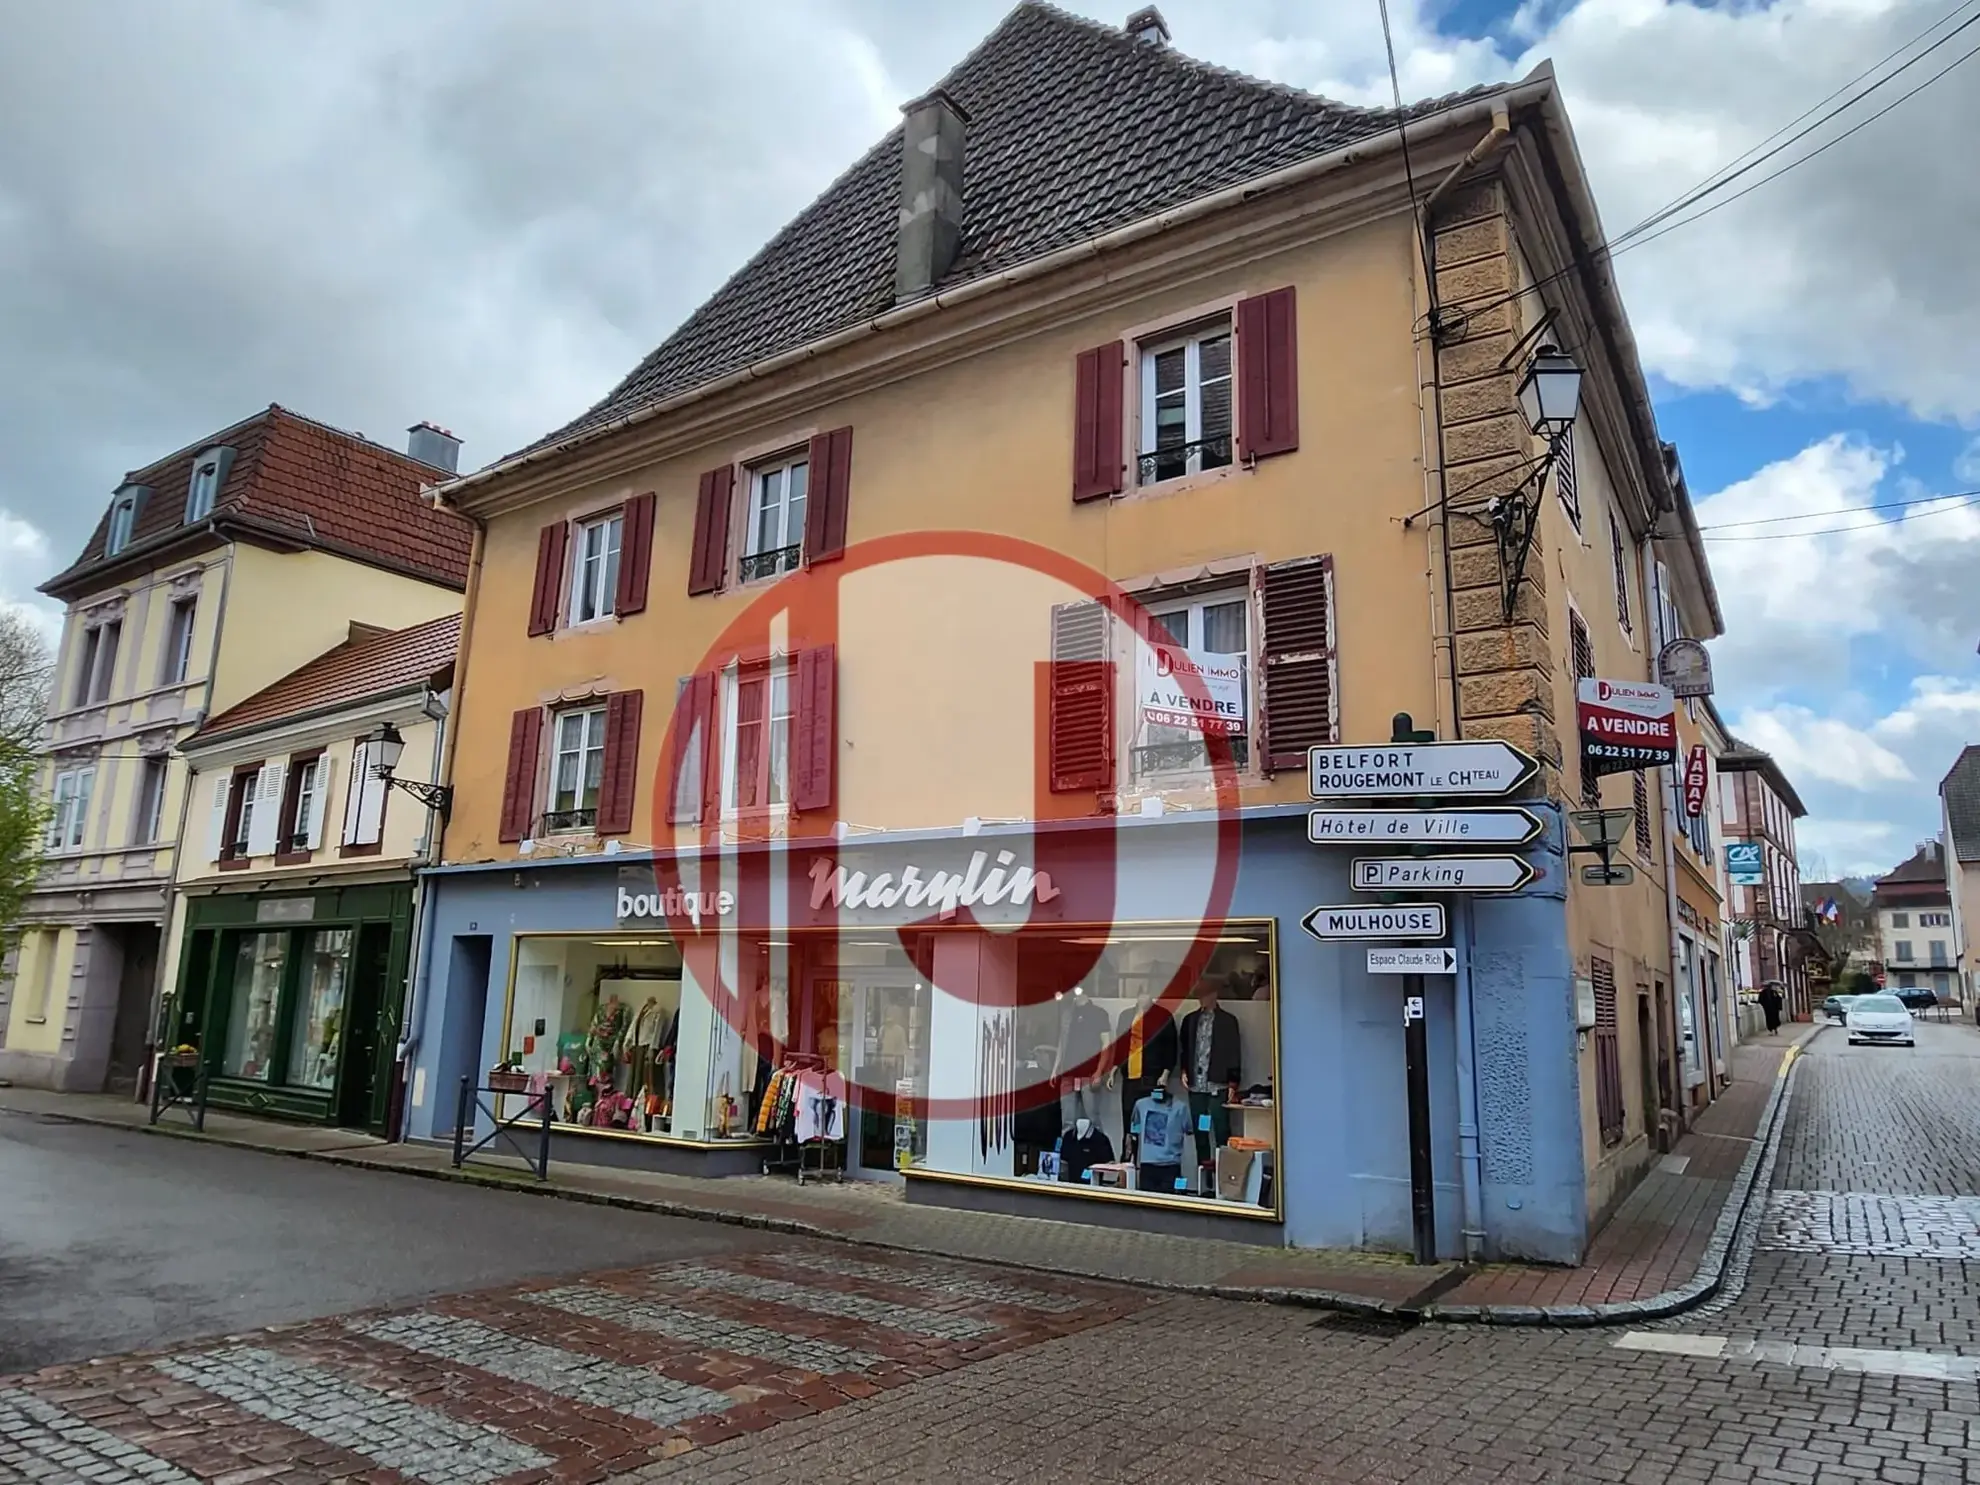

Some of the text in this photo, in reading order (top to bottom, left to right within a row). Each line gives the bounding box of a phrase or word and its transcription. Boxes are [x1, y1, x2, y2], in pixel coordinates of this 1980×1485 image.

[1207, 665, 1238, 679] IMMO
[1636, 690, 1660, 699] IMMO
[1166, 693, 1237, 714] VENDRE
[1156, 713, 1241, 731] 06 22 51 77 39
[1587, 716, 1670, 737] A VENDRE
[1319, 752, 1413, 769] BELFORT
[1588, 744, 1670, 761] 06 22 51 77 39
[1319, 772, 1425, 789] ROUGEMONT
[1430, 777, 1443, 786] LE
[1688, 747, 1704, 813] TABAC
[1320, 818, 1471, 834] Hôtel de Ville
[1388, 866, 1465, 884] Parking
[616, 884, 735, 925] boutique
[1329, 913, 1433, 930] MULHOUSE
[1370, 953, 1442, 966] Espace Claude Rich
